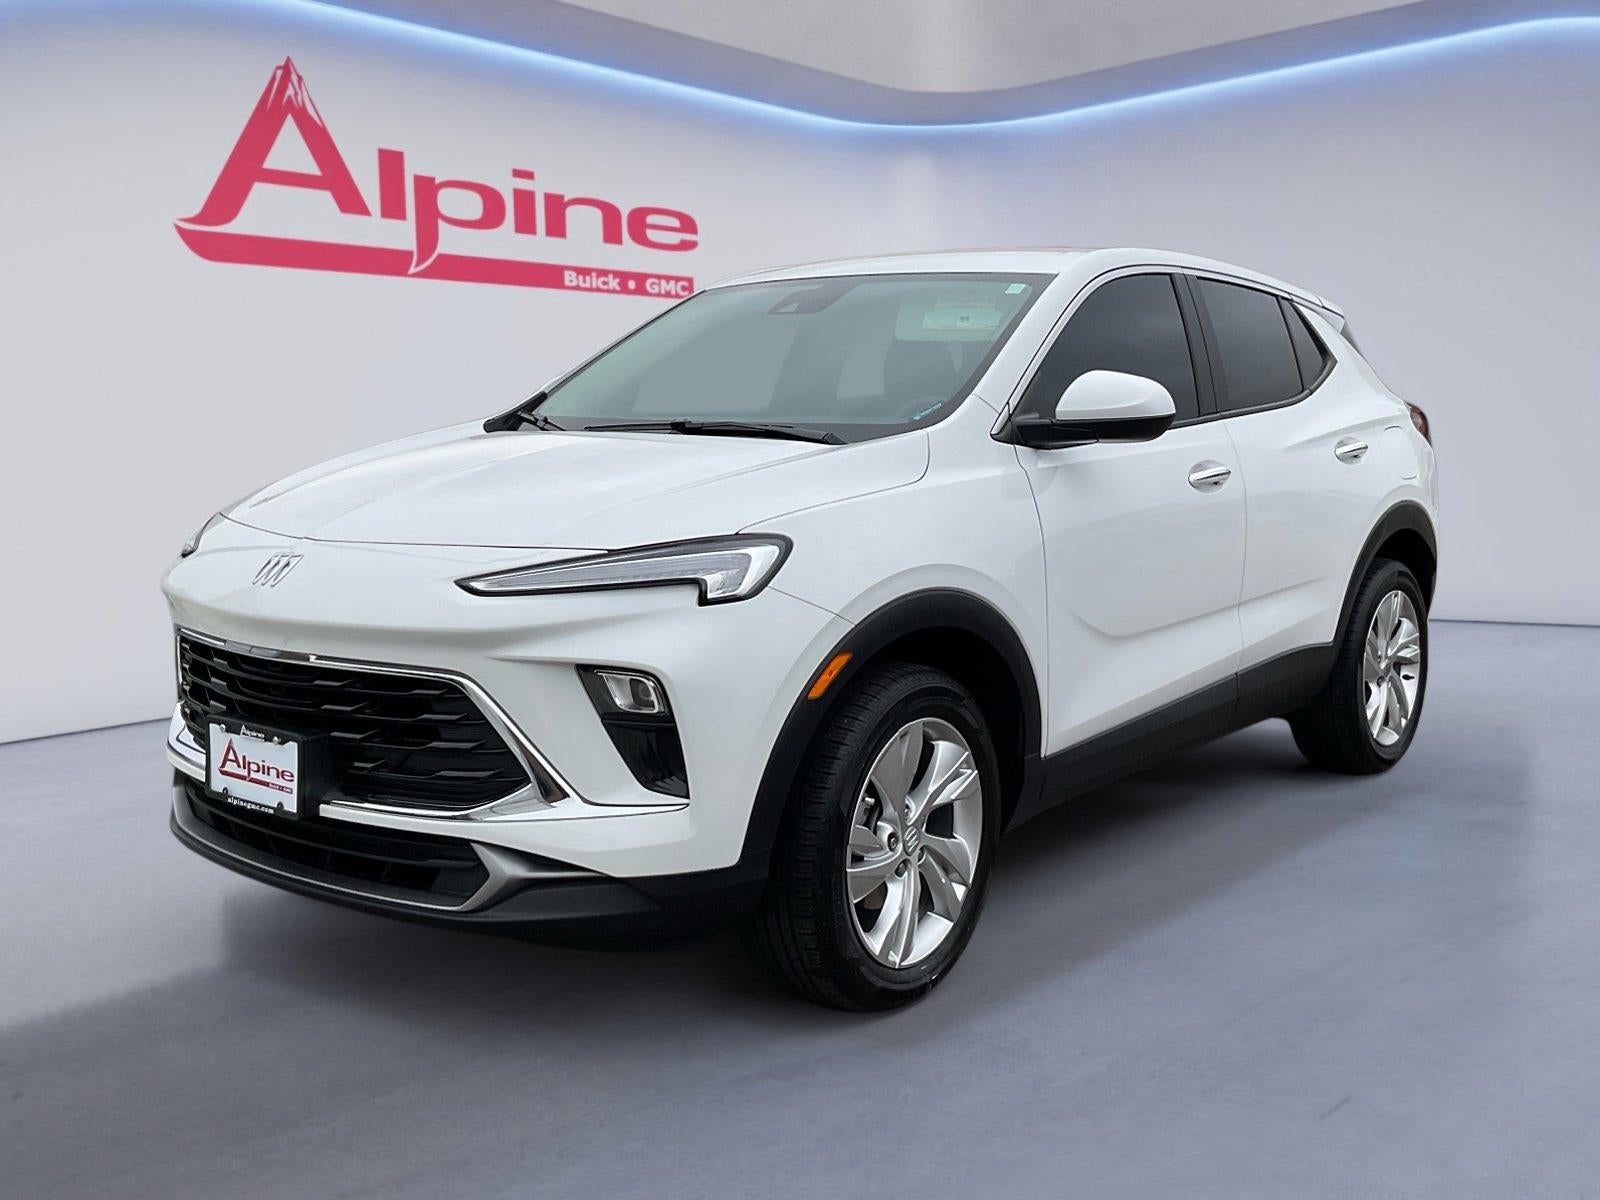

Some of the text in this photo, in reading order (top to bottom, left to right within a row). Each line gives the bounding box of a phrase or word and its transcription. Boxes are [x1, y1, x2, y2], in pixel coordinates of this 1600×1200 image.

[175, 56, 698, 272] Alpine
[564, 270, 690, 296] Buick GMC
[219, 738, 295, 782] Alpine
[227, 797, 275, 814] alpinegmc.com
